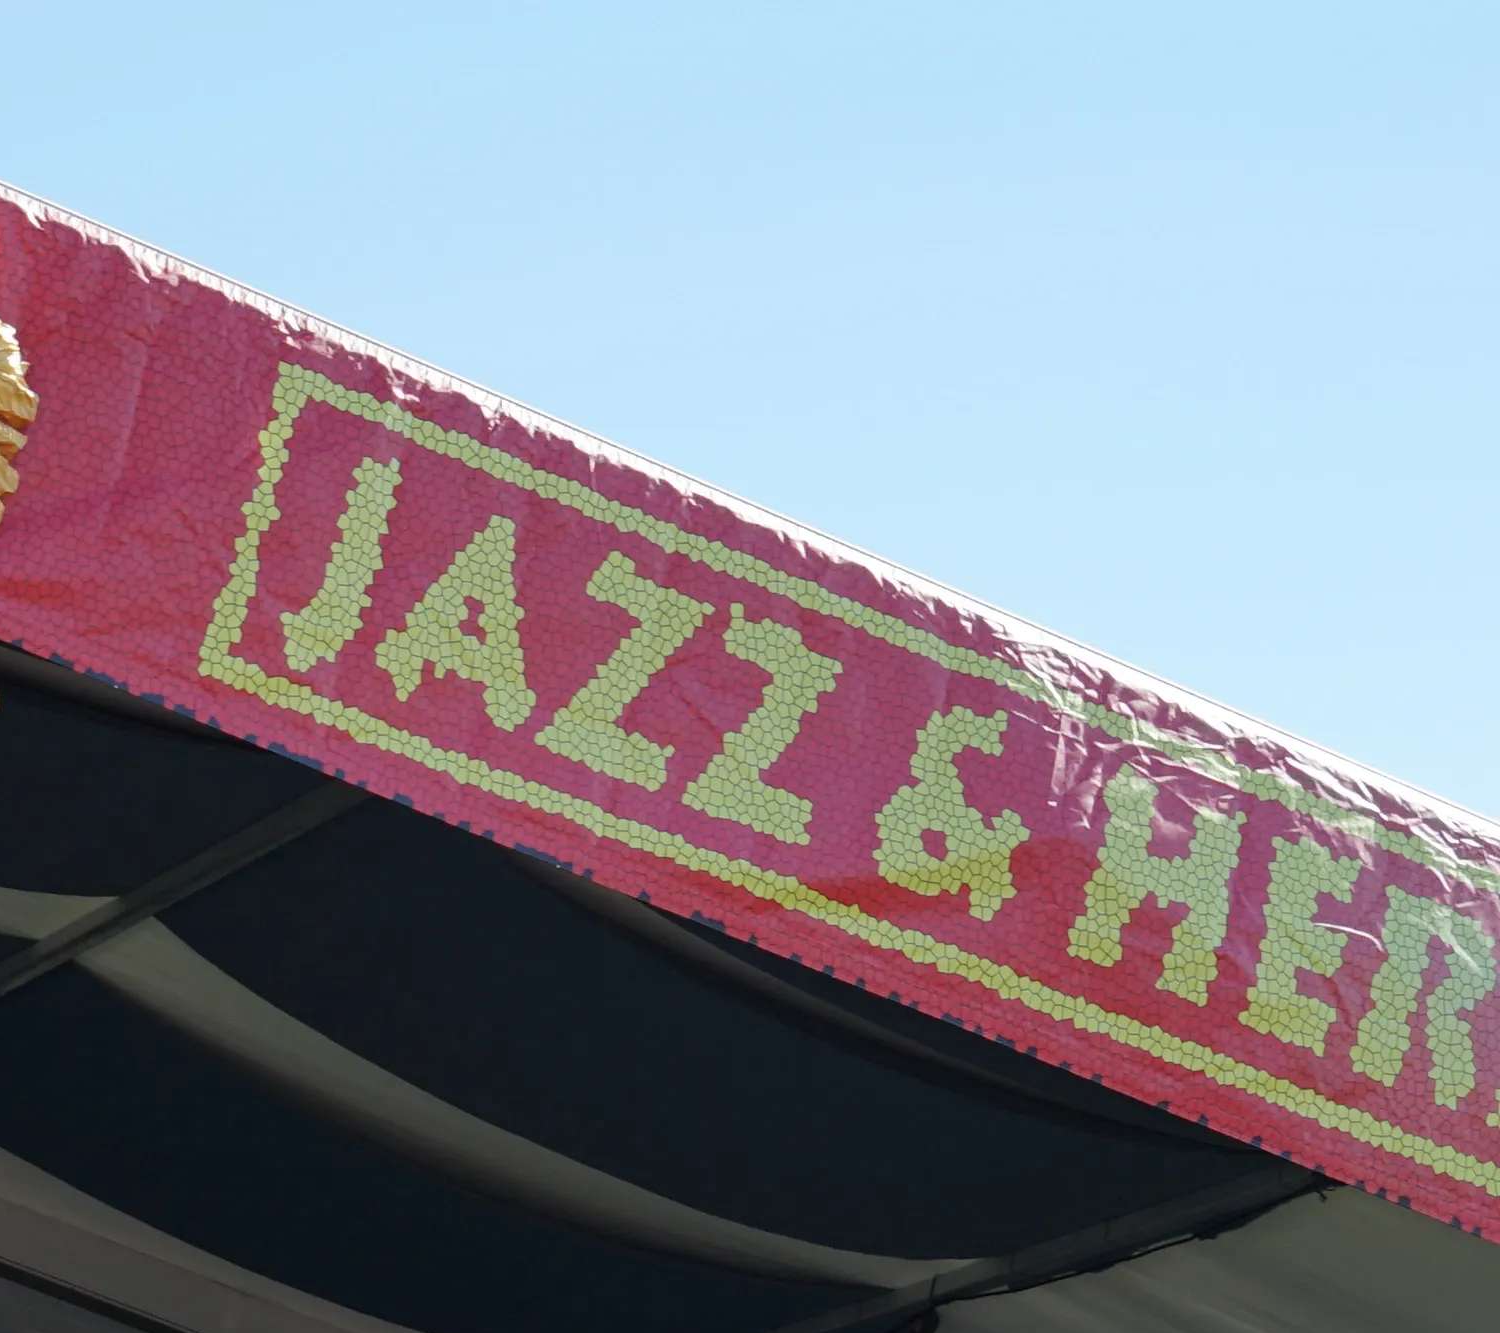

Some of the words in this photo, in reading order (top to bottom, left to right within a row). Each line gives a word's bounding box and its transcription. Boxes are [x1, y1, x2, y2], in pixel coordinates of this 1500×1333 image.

[282, 457, 844, 846] JAZZ
[872, 704, 1030, 921] &
[1066, 763, 1500, 1127] HER
